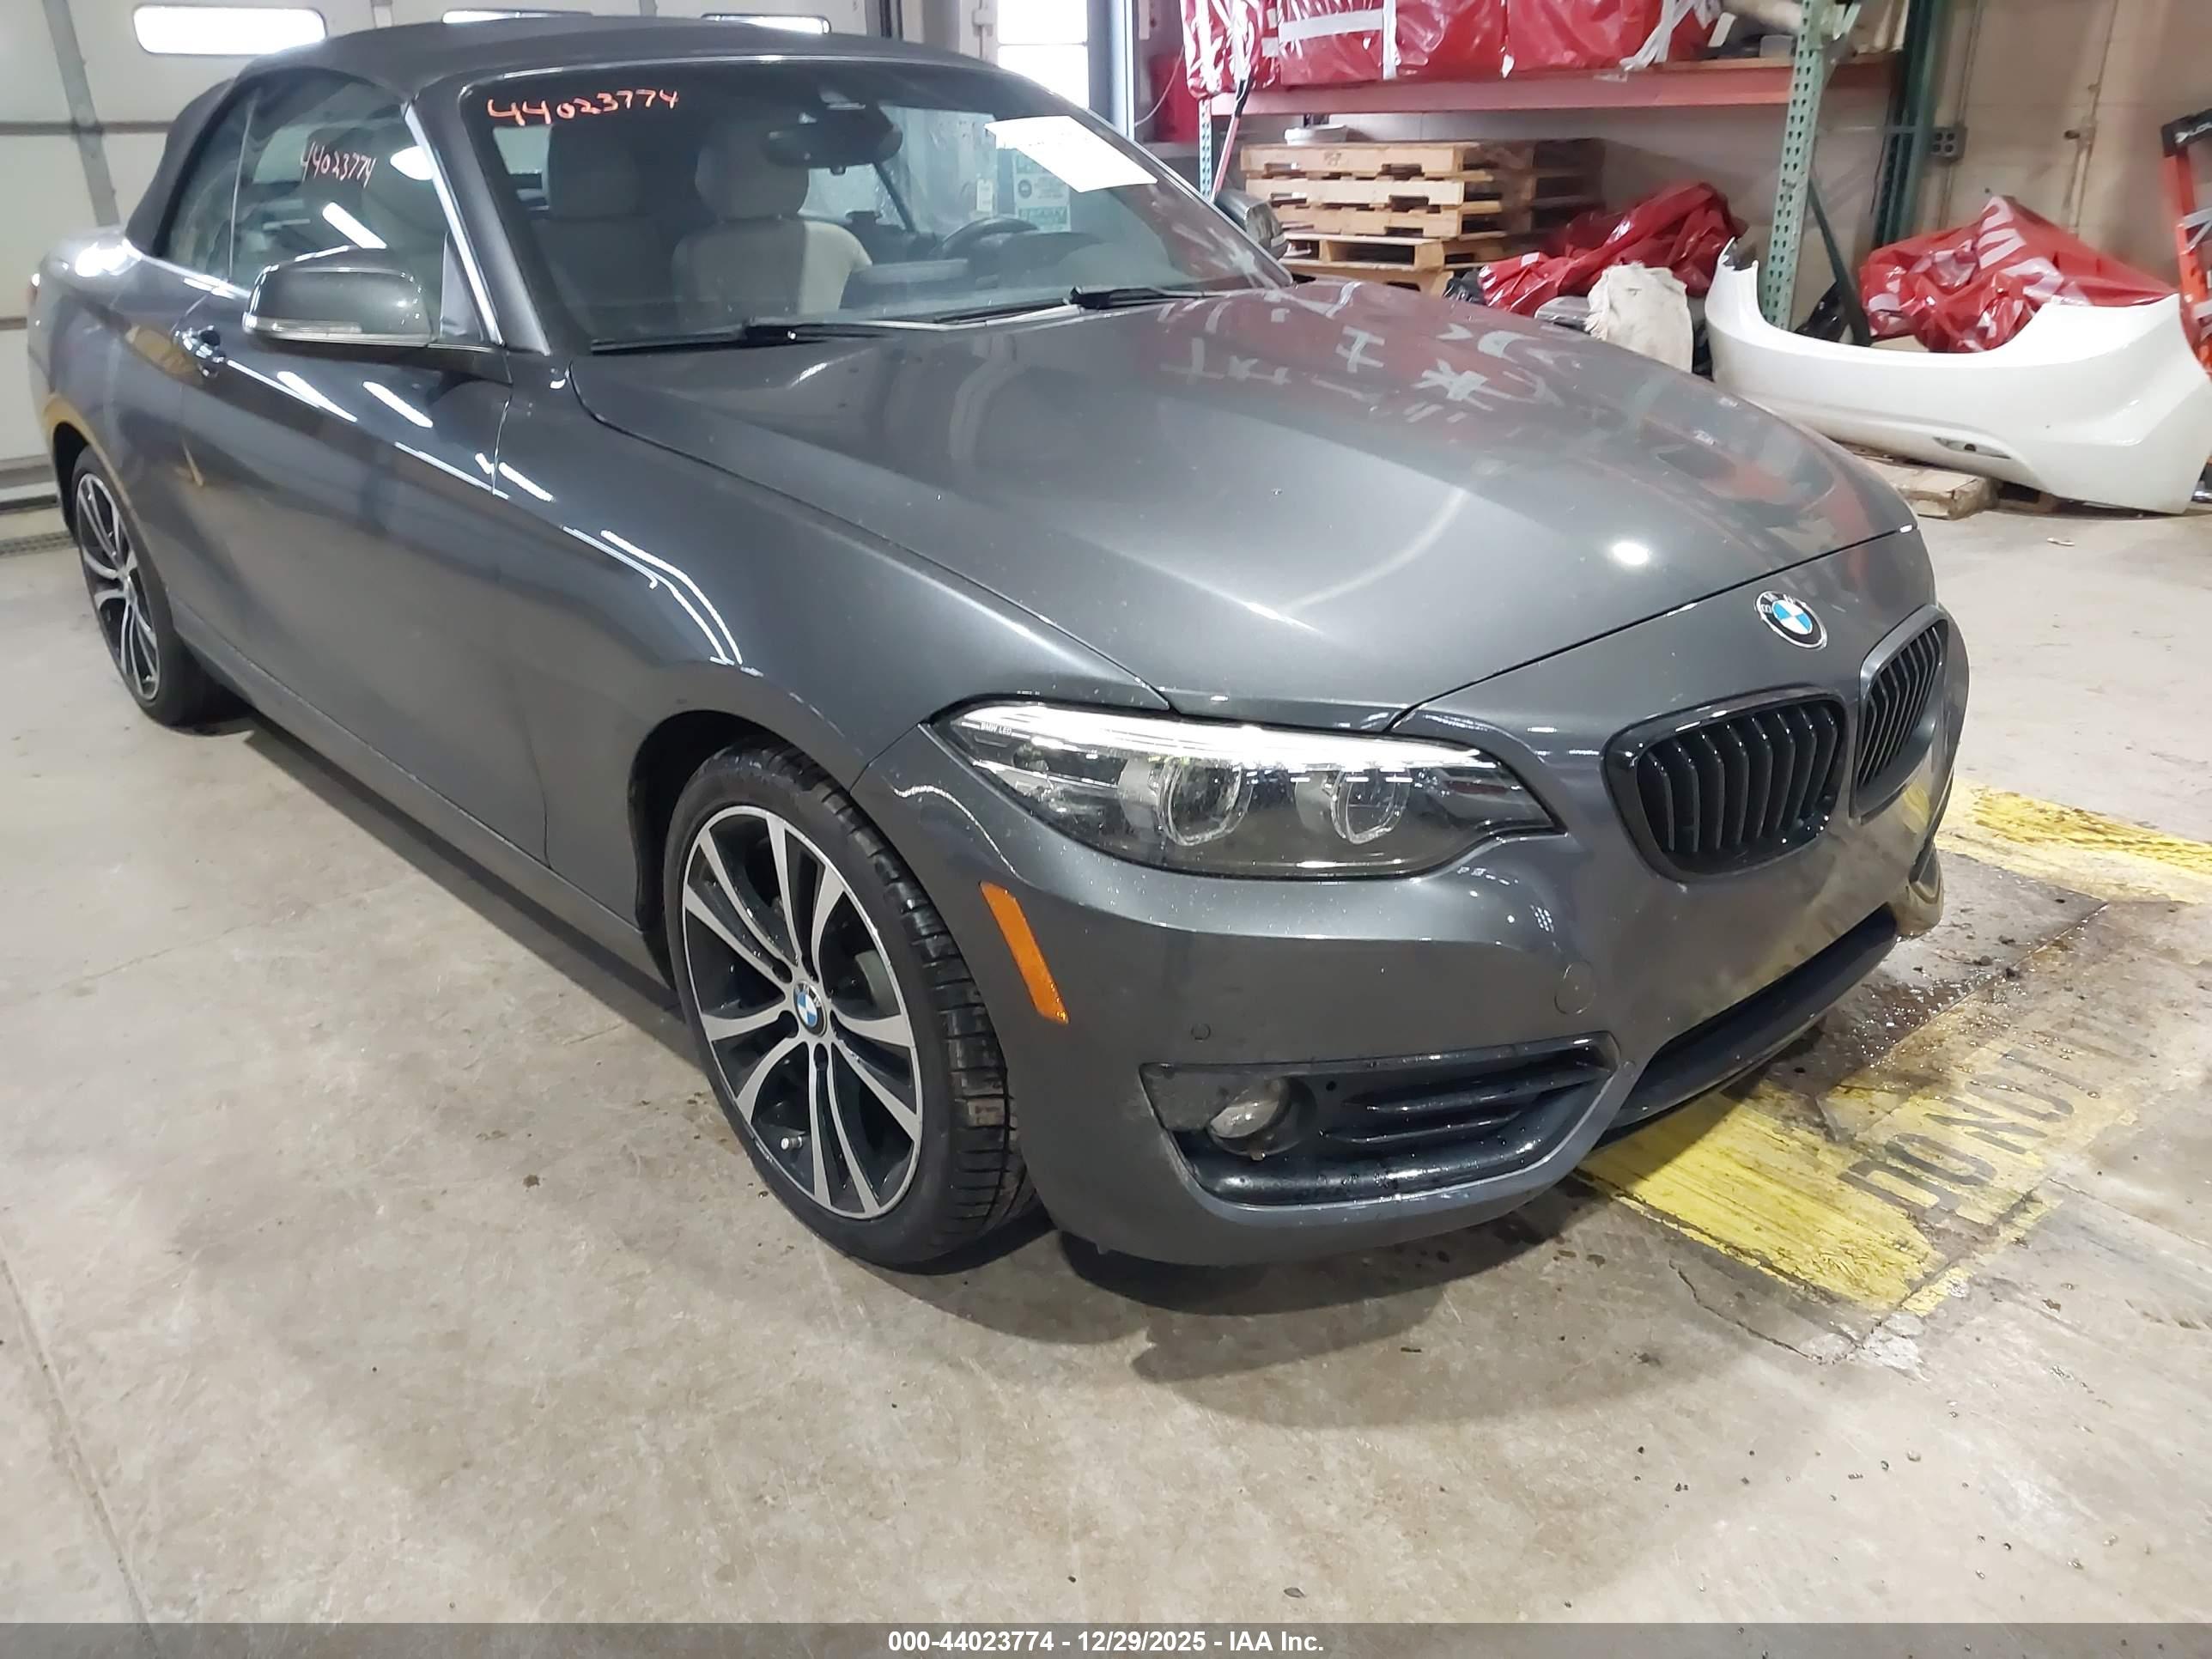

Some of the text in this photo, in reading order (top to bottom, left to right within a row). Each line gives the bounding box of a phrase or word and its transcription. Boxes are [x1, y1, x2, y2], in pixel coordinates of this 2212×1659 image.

[486, 88, 679, 126] 44023774
[300, 141, 377, 189] 44023774
[981, 721, 1012, 736] BMW LED
[1837, 1049, 2102, 1215] DO NOT
